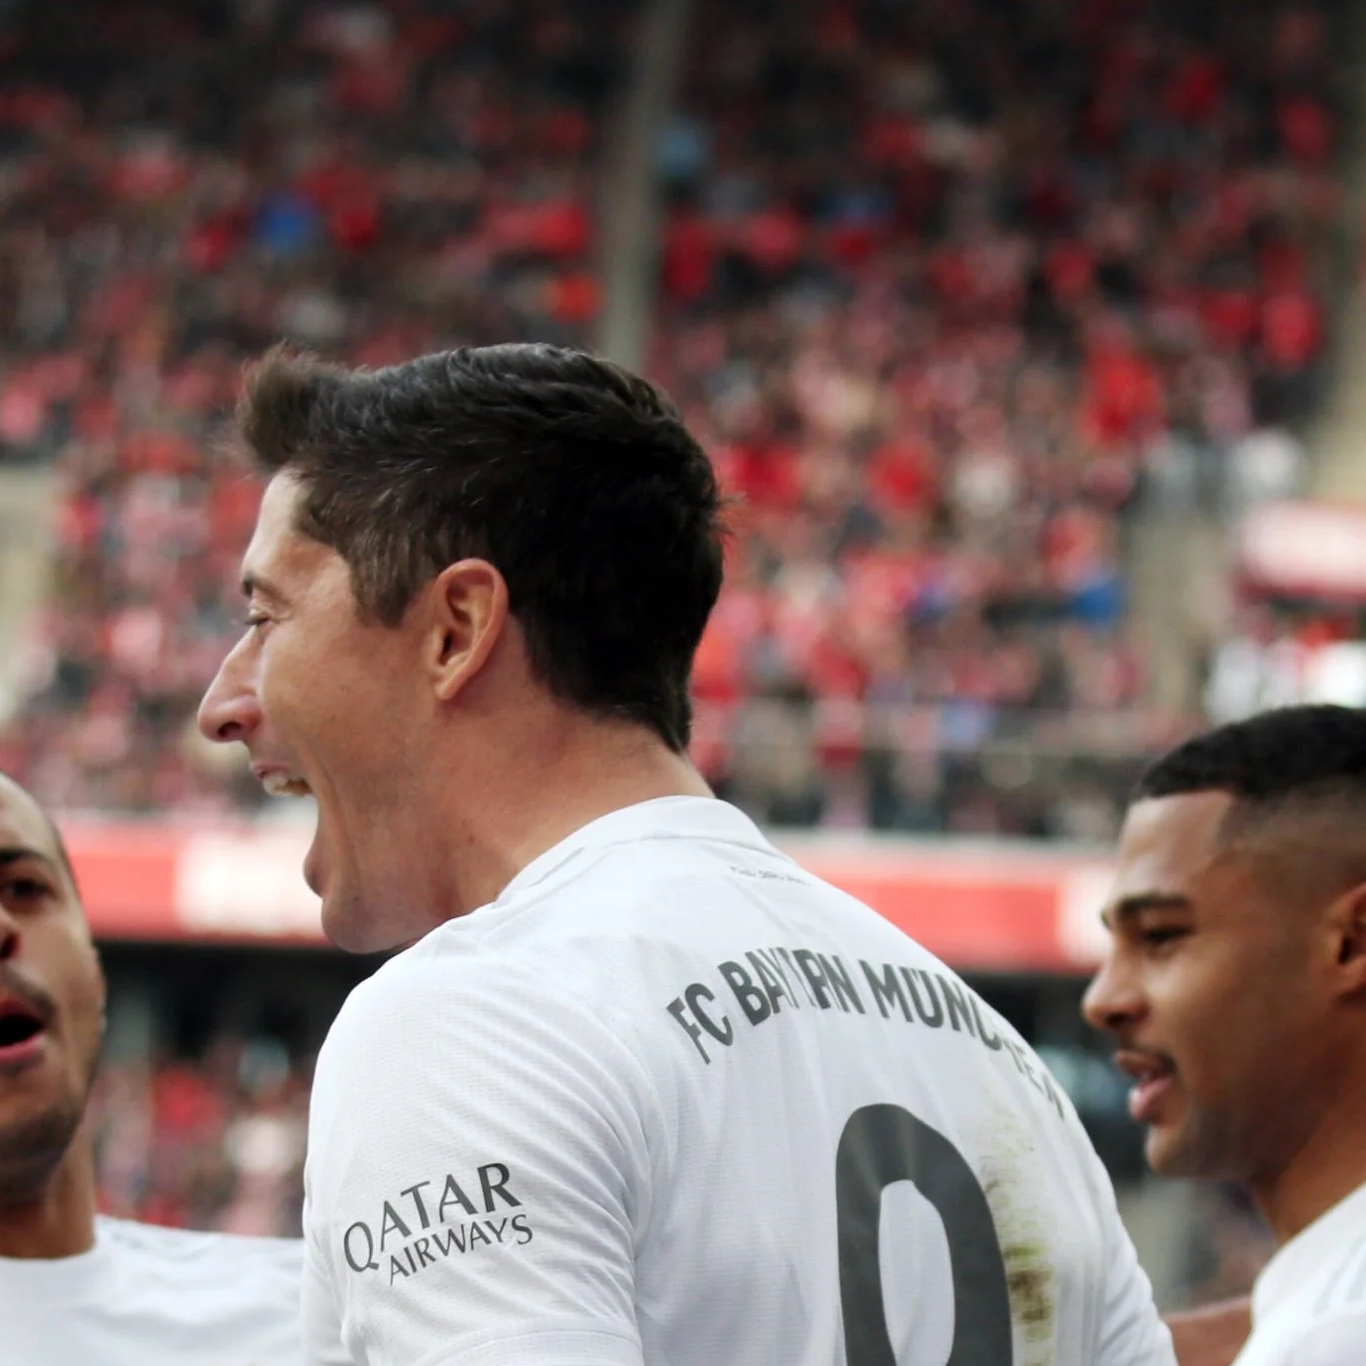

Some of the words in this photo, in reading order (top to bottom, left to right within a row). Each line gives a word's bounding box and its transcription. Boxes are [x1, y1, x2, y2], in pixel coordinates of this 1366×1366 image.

[666, 982, 734, 1064] FC
[718, 946, 866, 1026] BAYRN
[343, 1162, 523, 1273] QATAR
[388, 1214, 534, 1287] AIRWAYS
